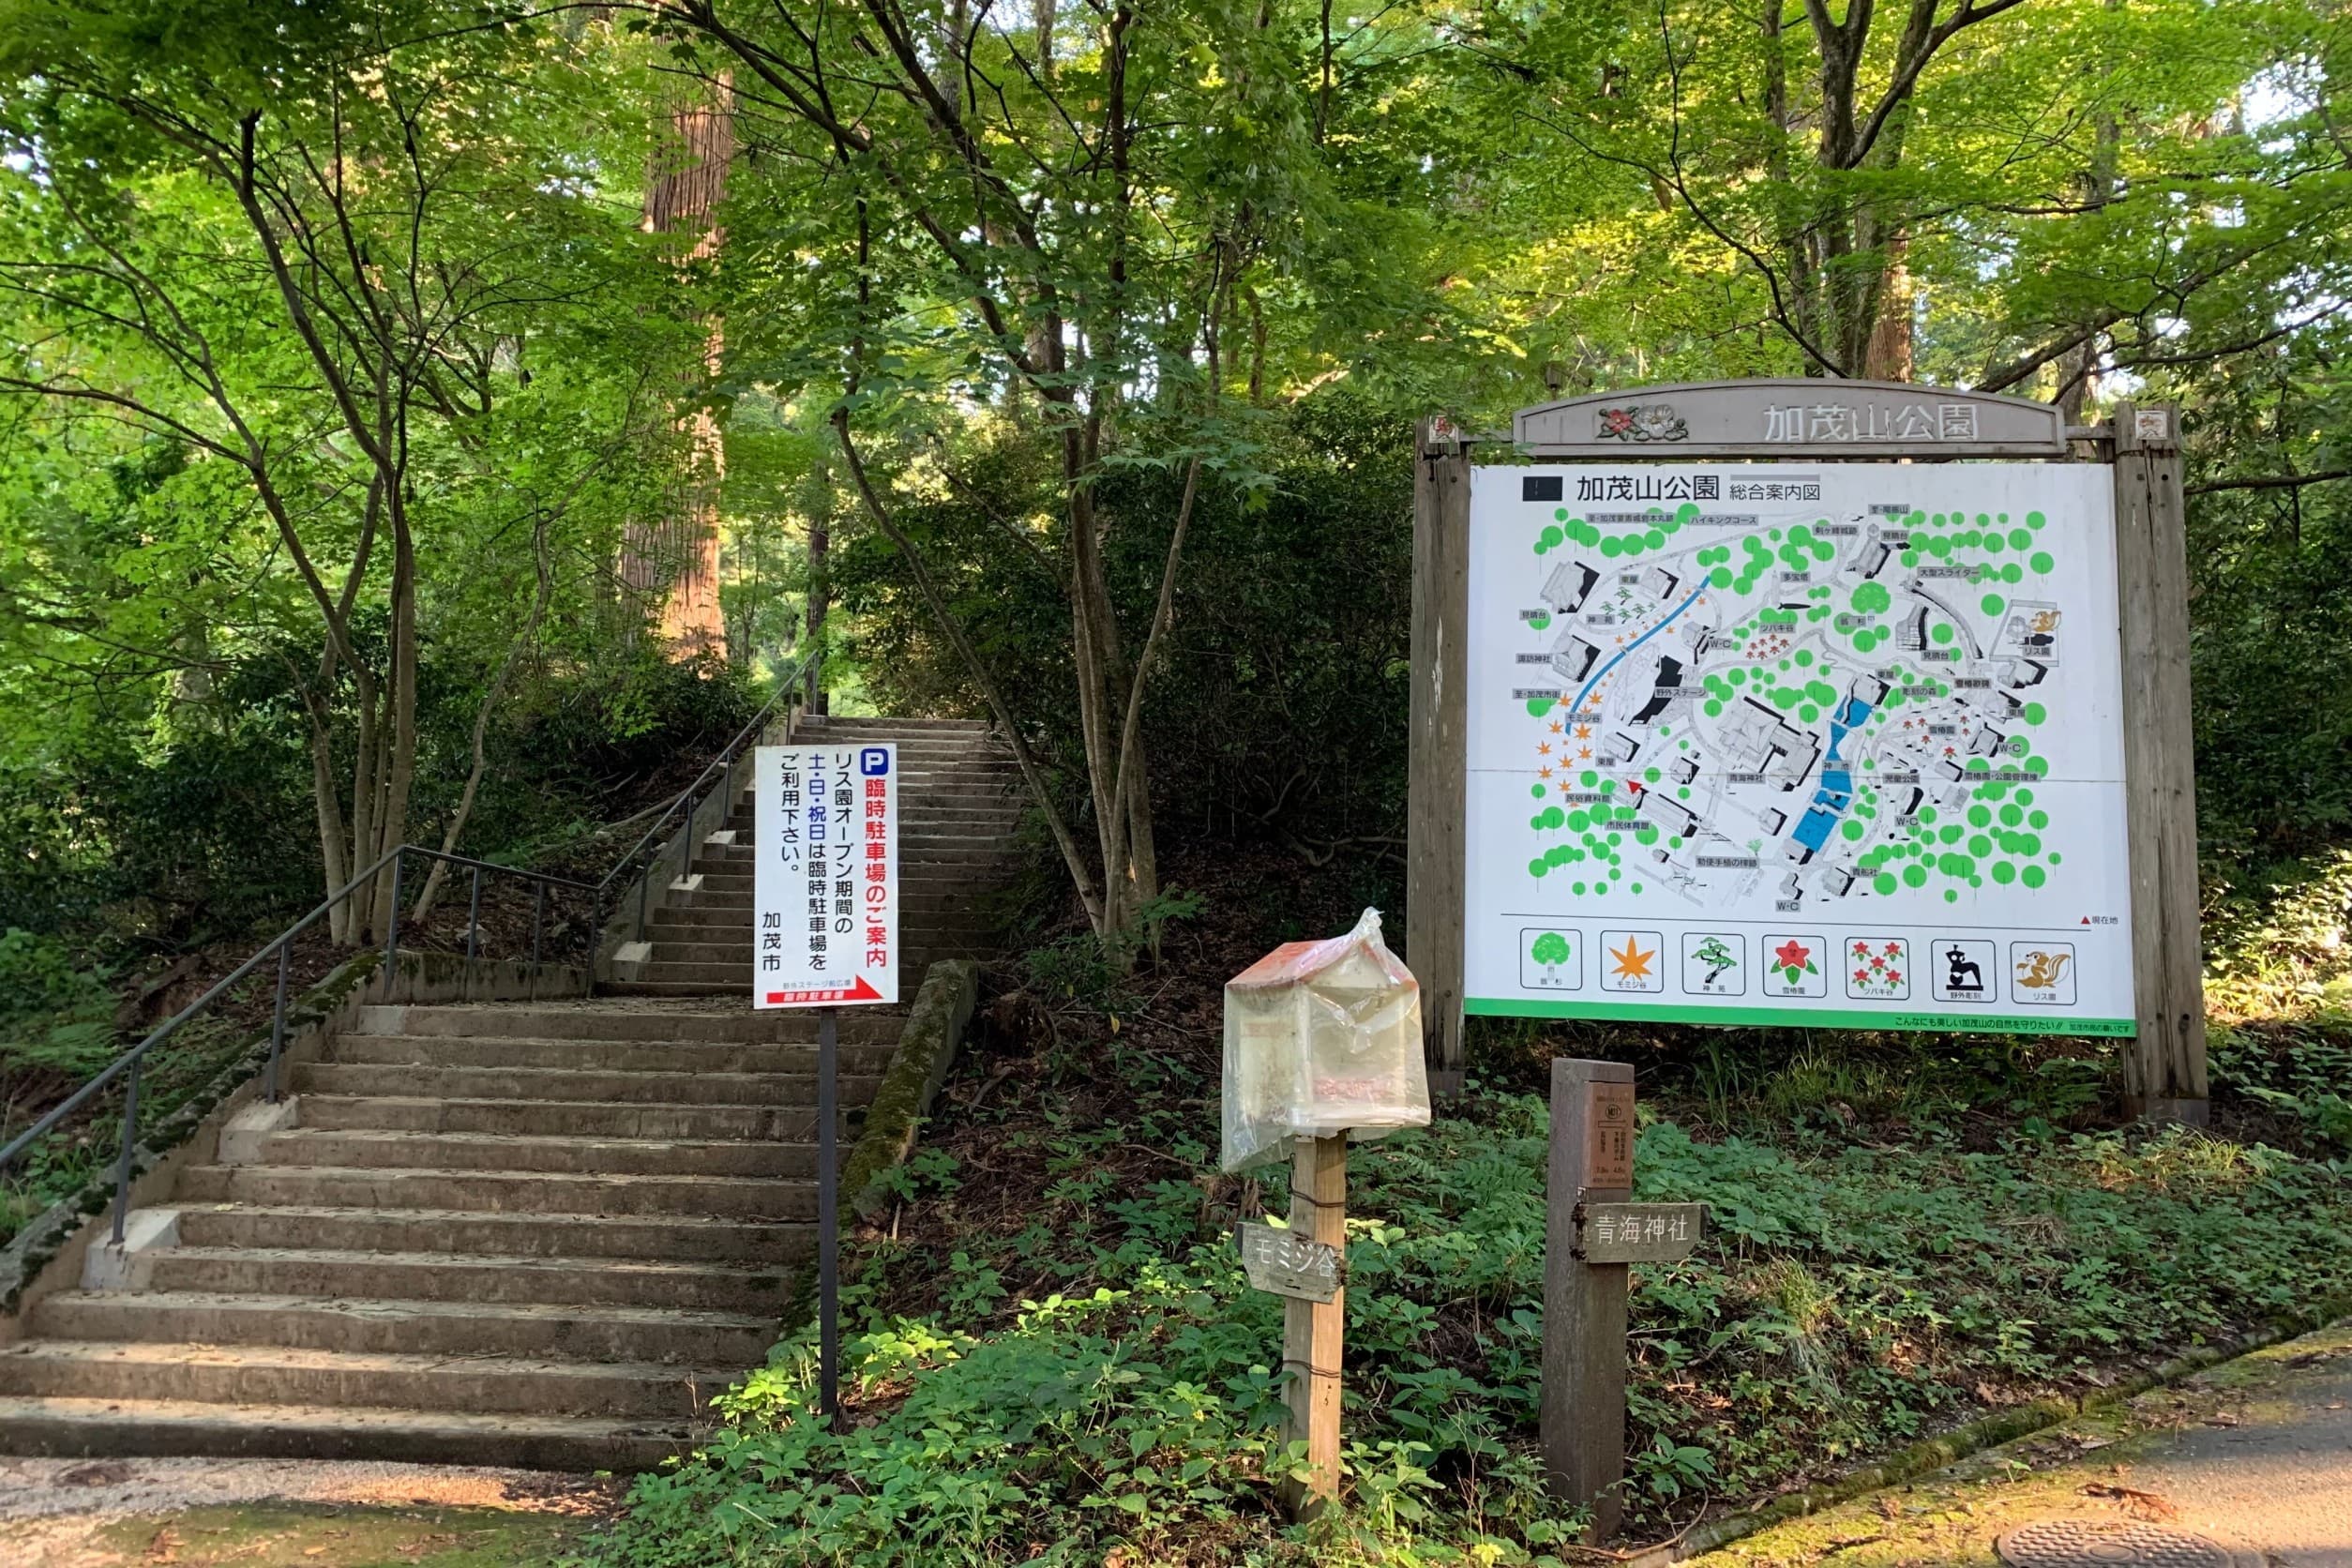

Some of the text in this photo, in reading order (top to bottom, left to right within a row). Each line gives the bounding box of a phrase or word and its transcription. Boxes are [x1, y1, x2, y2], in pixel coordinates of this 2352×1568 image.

[1763, 402, 1979, 442] 加茂山公園
[1577, 475, 1720, 501] 加茂山公園
[1729, 483, 1820, 501] 総合案内図
[1883, 531, 1908, 540] 見晴台
[1783, 573, 1809, 581] 多宝塔
[1920, 568, 1980, 577] 大型スライダー
[1521, 611, 1545, 620] 見晴台
[1760, 624, 1794, 633] ツバキ谷
[1923, 651, 1950, 660] 見晴台
[2025, 647, 2051, 656] リス園
[1655, 688, 1706, 698] 野外ステージ
[1902, 687, 1937, 696] 彫刻の森
[1567, 714, 1601, 723] モミジ谷
[781, 754, 800, 872] ご利用下さい。
[835, 753, 852, 934] リス園オープン期間の
[808, 753, 827, 971] 土・日・祝日は臨時駐車場を
[865, 778, 886, 969] 臨時駐車場のご案内
[2091, 915, 2118, 925] 現在地
[762, 912, 781, 972] 加茂市
[1617, 980, 1647, 989] モミジ谷
[1862, 988, 1893, 996] ツバキ谷
[1950, 991, 1982, 1000] 野外彫刻
[2033, 992, 2057, 1001] リス園
[1594, 1213, 1689, 1244] 青海神社
[1256, 1239, 1335, 1277] モミジ谷
